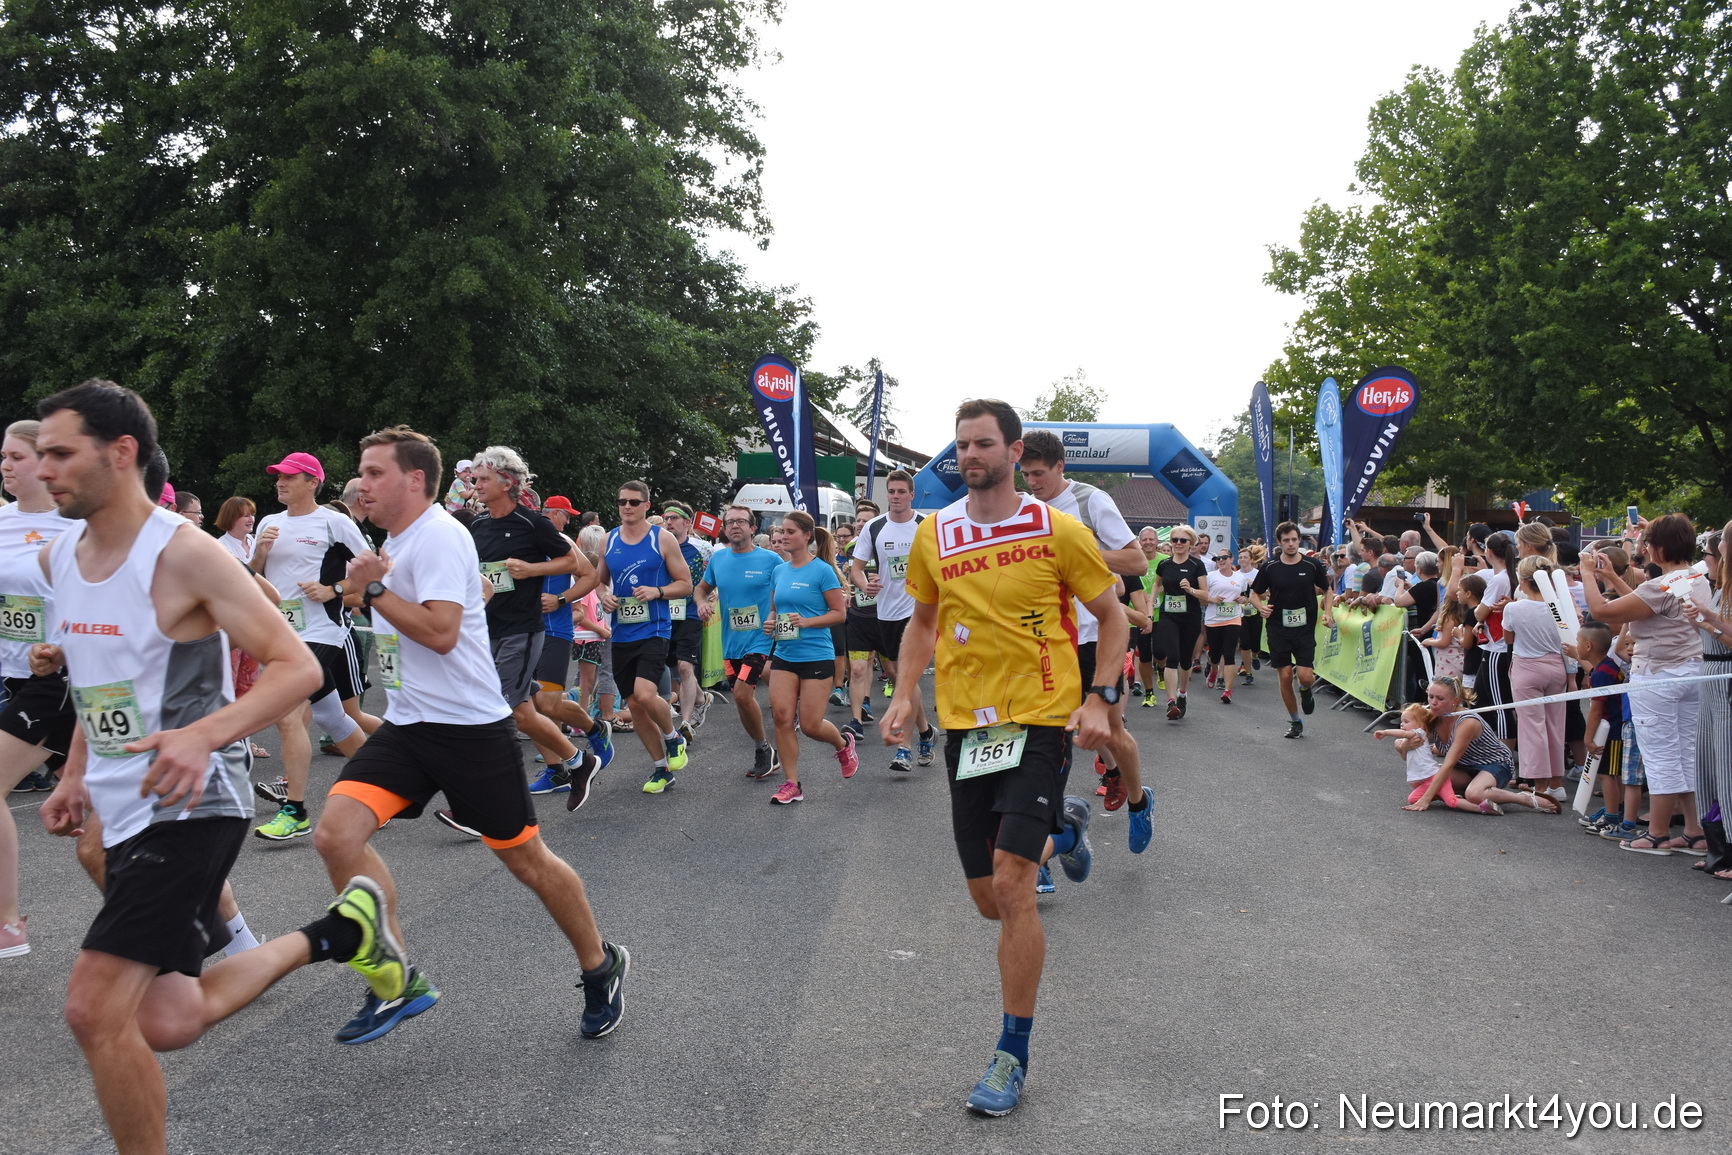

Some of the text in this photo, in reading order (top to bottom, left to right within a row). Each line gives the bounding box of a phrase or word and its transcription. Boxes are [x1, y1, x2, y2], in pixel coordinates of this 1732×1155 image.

[1362, 387, 1409, 407] Hervis
[1065, 447, 1111, 459] menlauf
[1356, 422, 1400, 494] MOVIN
[941, 544, 1056, 582] MAX BÖGL
[619, 605, 645, 617] 1523
[1168, 601, 1182, 609] 953
[732, 614, 756, 626] 1847
[1287, 614, 1301, 623] 951
[71, 622, 124, 637] KLEBL
[776, 622, 795, 633] 1854
[969, 740, 1015, 765] 1561
